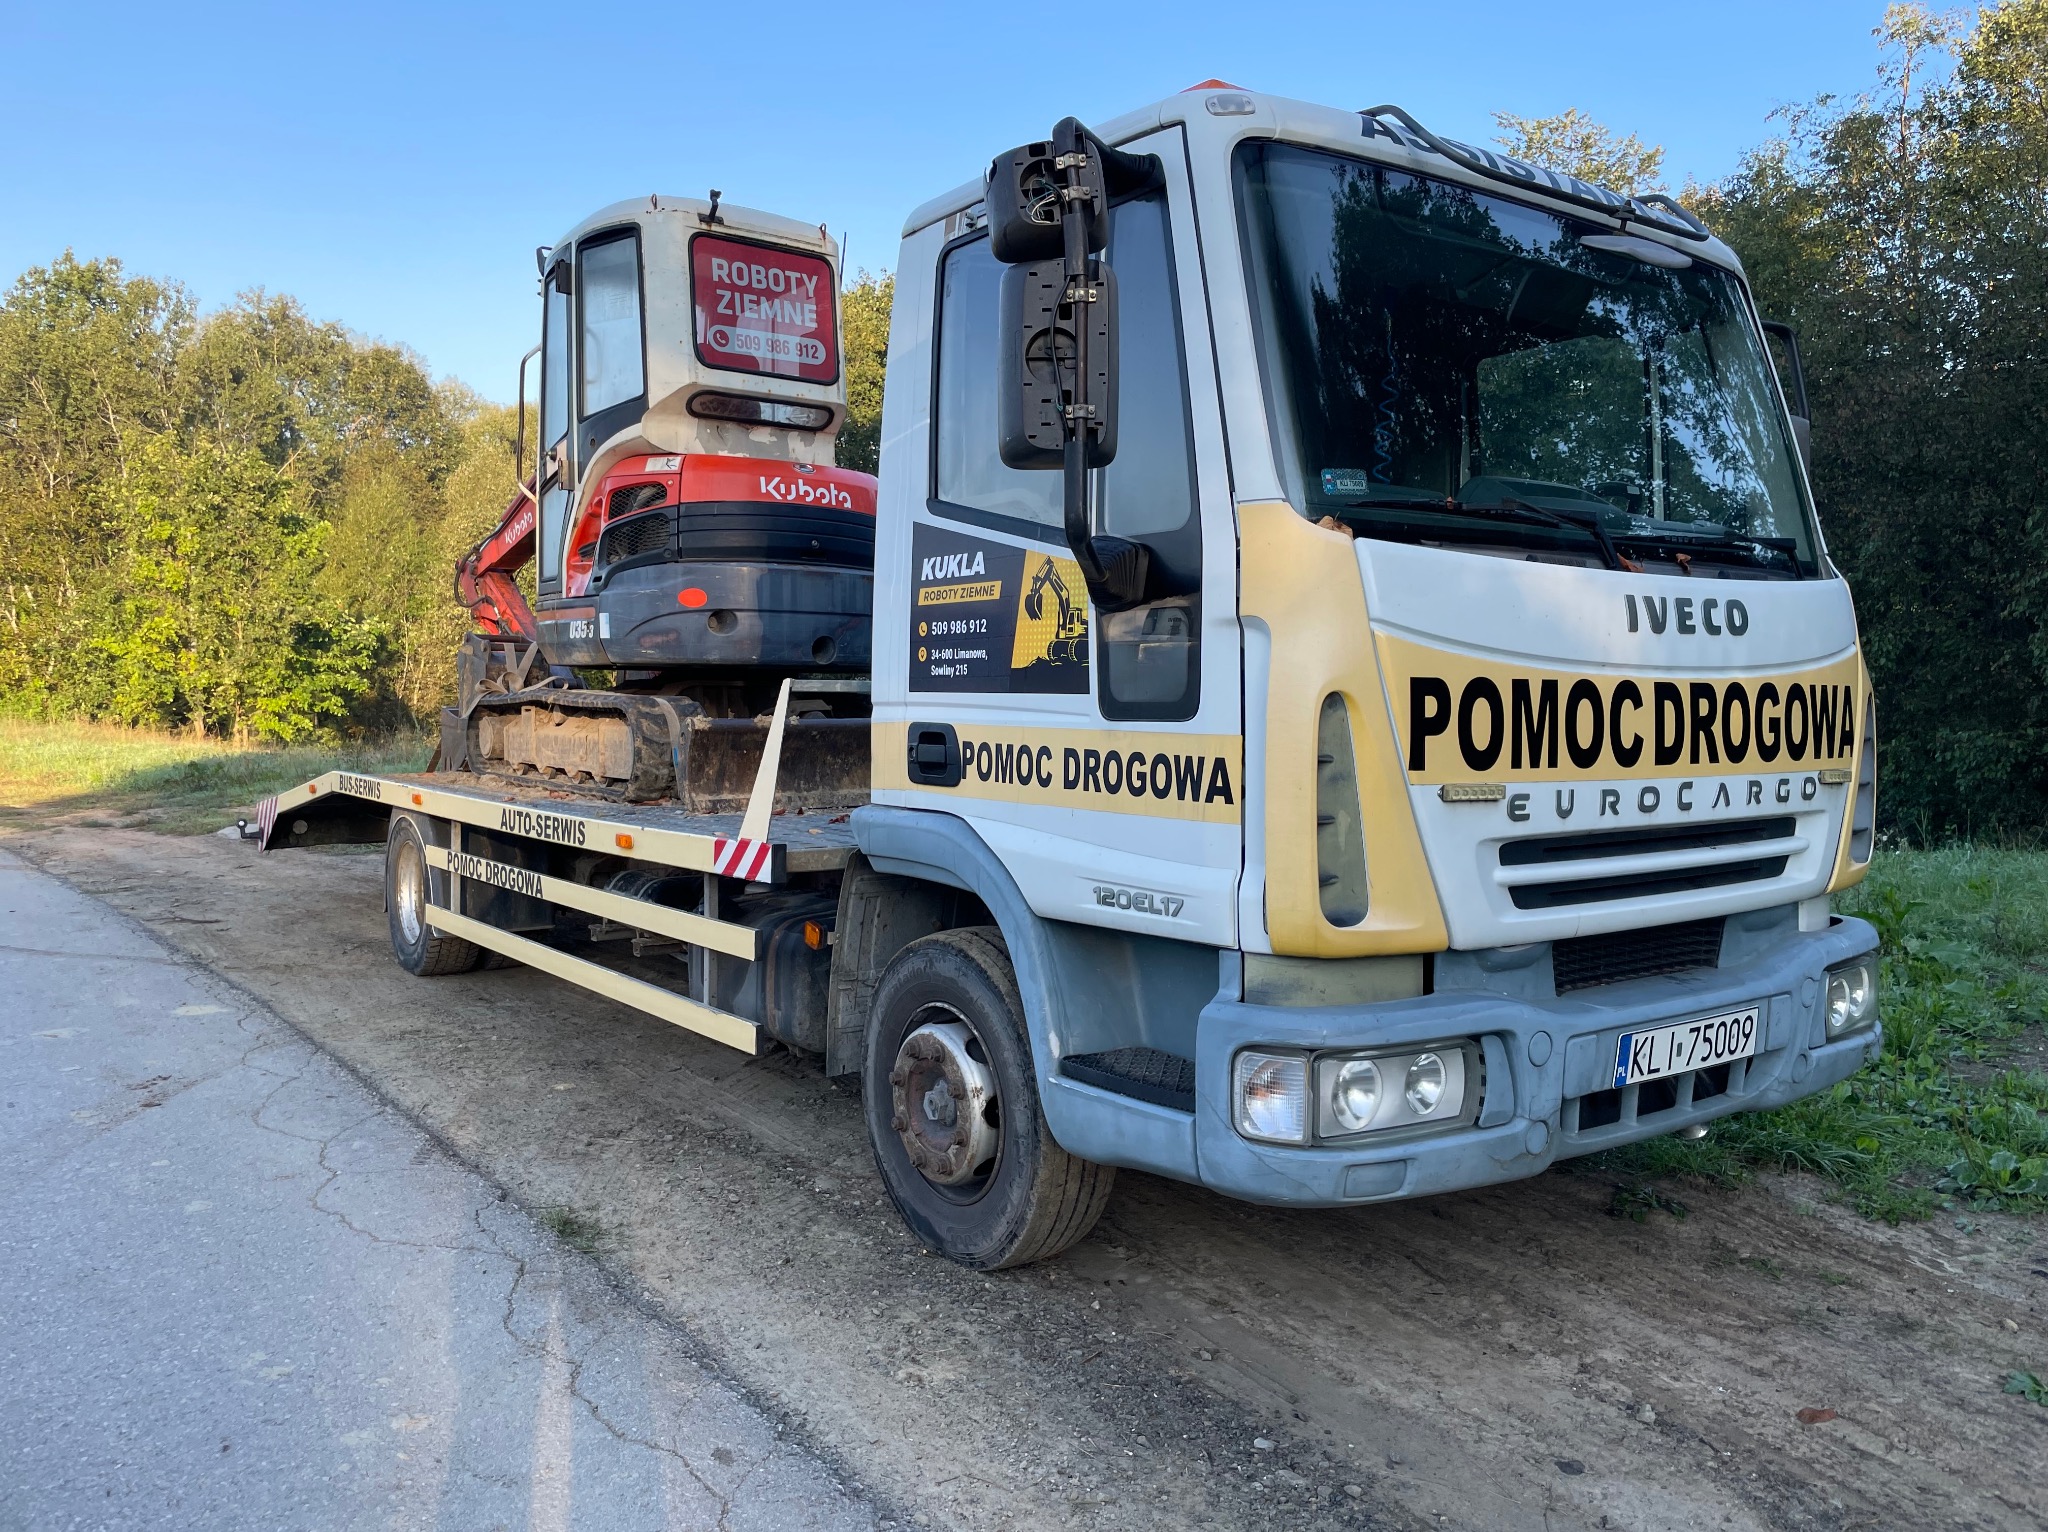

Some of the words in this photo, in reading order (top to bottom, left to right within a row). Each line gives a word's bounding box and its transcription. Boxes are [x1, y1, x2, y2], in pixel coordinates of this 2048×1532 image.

[711, 257, 818, 298] ROBOTY
[716, 289, 818, 328] ZIEMNE
[735, 333, 760, 351] 509
[766, 337, 790, 356] 986
[795, 342, 819, 359] 912
[760, 476, 852, 509] Kubota
[504, 511, 533, 544] Kubota
[921, 551, 986, 581] KUKLA
[923, 588, 959, 602] ROBOTY
[960, 584, 996, 599] ZIEMNE
[569, 620, 594, 639] U35-3
[931, 621, 948, 636] 509
[950, 620, 967, 634] 986
[969, 618, 987, 633] 912
[1623, 594, 1749, 637] IVECO
[930, 648, 953, 660] 34-600
[954, 647, 988, 661] Limanowa,
[930, 664, 954, 679] Sowliny
[955, 664, 968, 676] 215
[1408, 676, 1645, 772] POMOC
[1654, 681, 1854, 767] DROGOWA
[339, 774, 381, 800] BUS-SERWIS
[961, 740, 1053, 788] POMOC
[1063, 747, 1235, 806] DROGOWA
[1506, 776, 1817, 822] EUROCARGO
[500, 807, 586, 847] AUTO-SERWIS
[447, 850, 483, 881] POMOC
[485, 861, 544, 899] DROGOWA
[1092, 885, 1185, 918] 120EL17
[1630, 1031, 1675, 1079] KLI
[1686, 1015, 1754, 1067] 75009
[1616, 1066, 1627, 1078] PL
